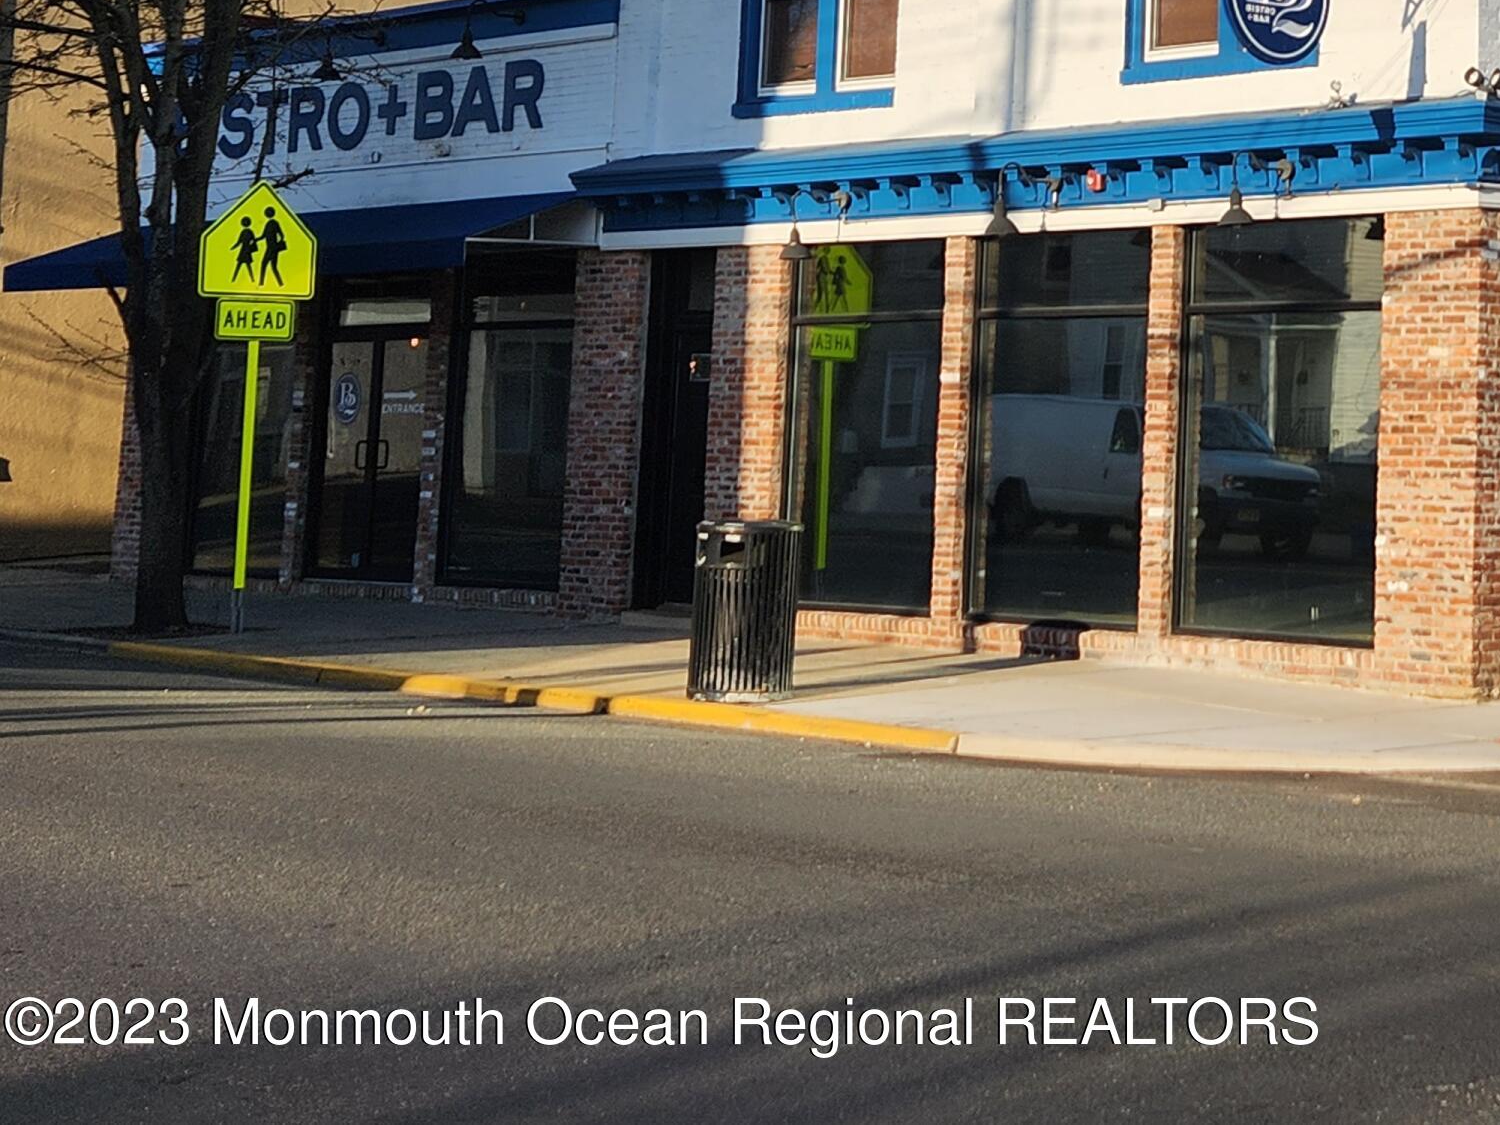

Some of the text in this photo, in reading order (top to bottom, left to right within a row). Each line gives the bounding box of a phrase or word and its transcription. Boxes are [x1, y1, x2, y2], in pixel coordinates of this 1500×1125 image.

[1245, 3, 1276, 16] BISTRO
[174, 59, 545, 161] STRO+BAR
[223, 309, 287, 330] AHEAD
